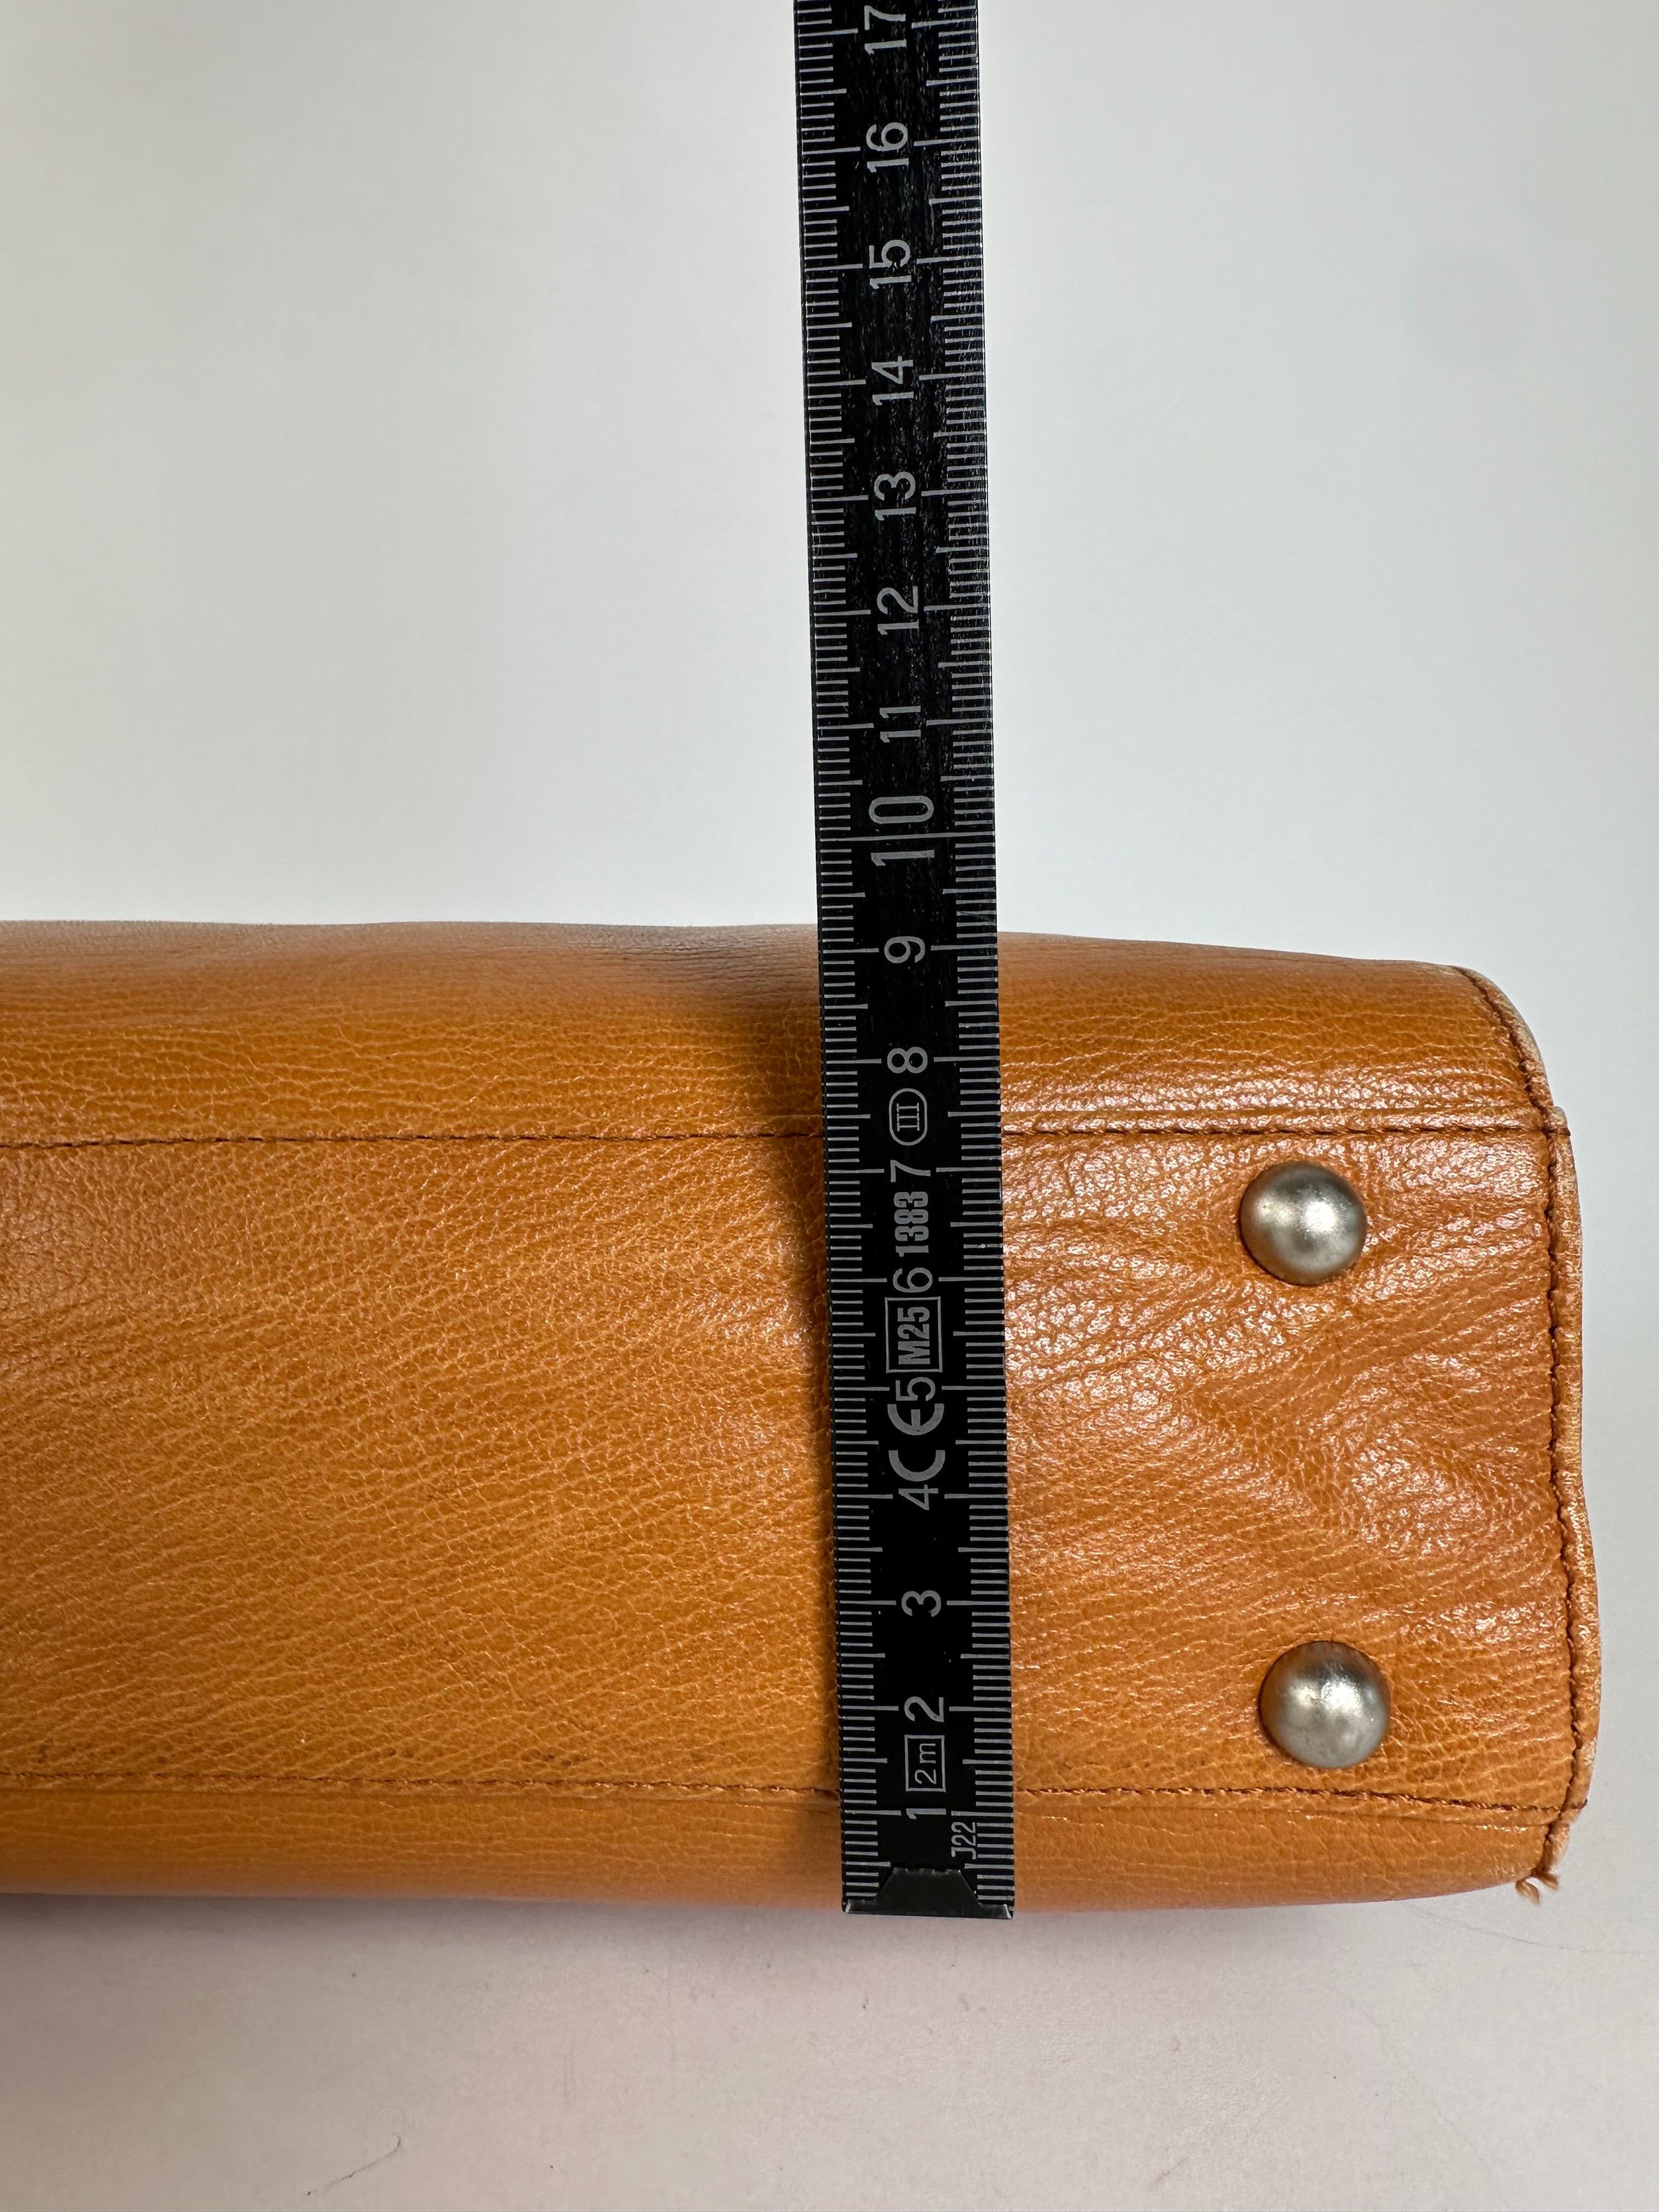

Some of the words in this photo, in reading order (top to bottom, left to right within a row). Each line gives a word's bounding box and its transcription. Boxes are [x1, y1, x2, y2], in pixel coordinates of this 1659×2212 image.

[865, 5, 906, 54] 17
[866, 122, 909, 173] 16
[869, 240, 911, 289] 15
[872, 356, 914, 406] 14
[874, 471, 916, 521] 13
[877, 585, 919, 635] 12
[880, 705, 921, 743] 11
[869, 796, 935, 866] 10
[884, 936, 925, 964] 9
[887, 1047, 928, 1074] 8
[890, 1160, 931, 1182] 7
[894, 1191, 929, 1257] 1383
[892, 1267, 933, 1293] 6
[897, 1306, 930, 1364] M25
[896, 1376, 935, 1401] 5
[887, 1403, 945, 1481] CE
[898, 1485, 939, 1510] 4
[901, 1590, 941, 1617] 3
[904, 1696, 944, 1722] 2
[906, 1808, 946, 1820] 1
[951, 1821, 976, 1859] J22
